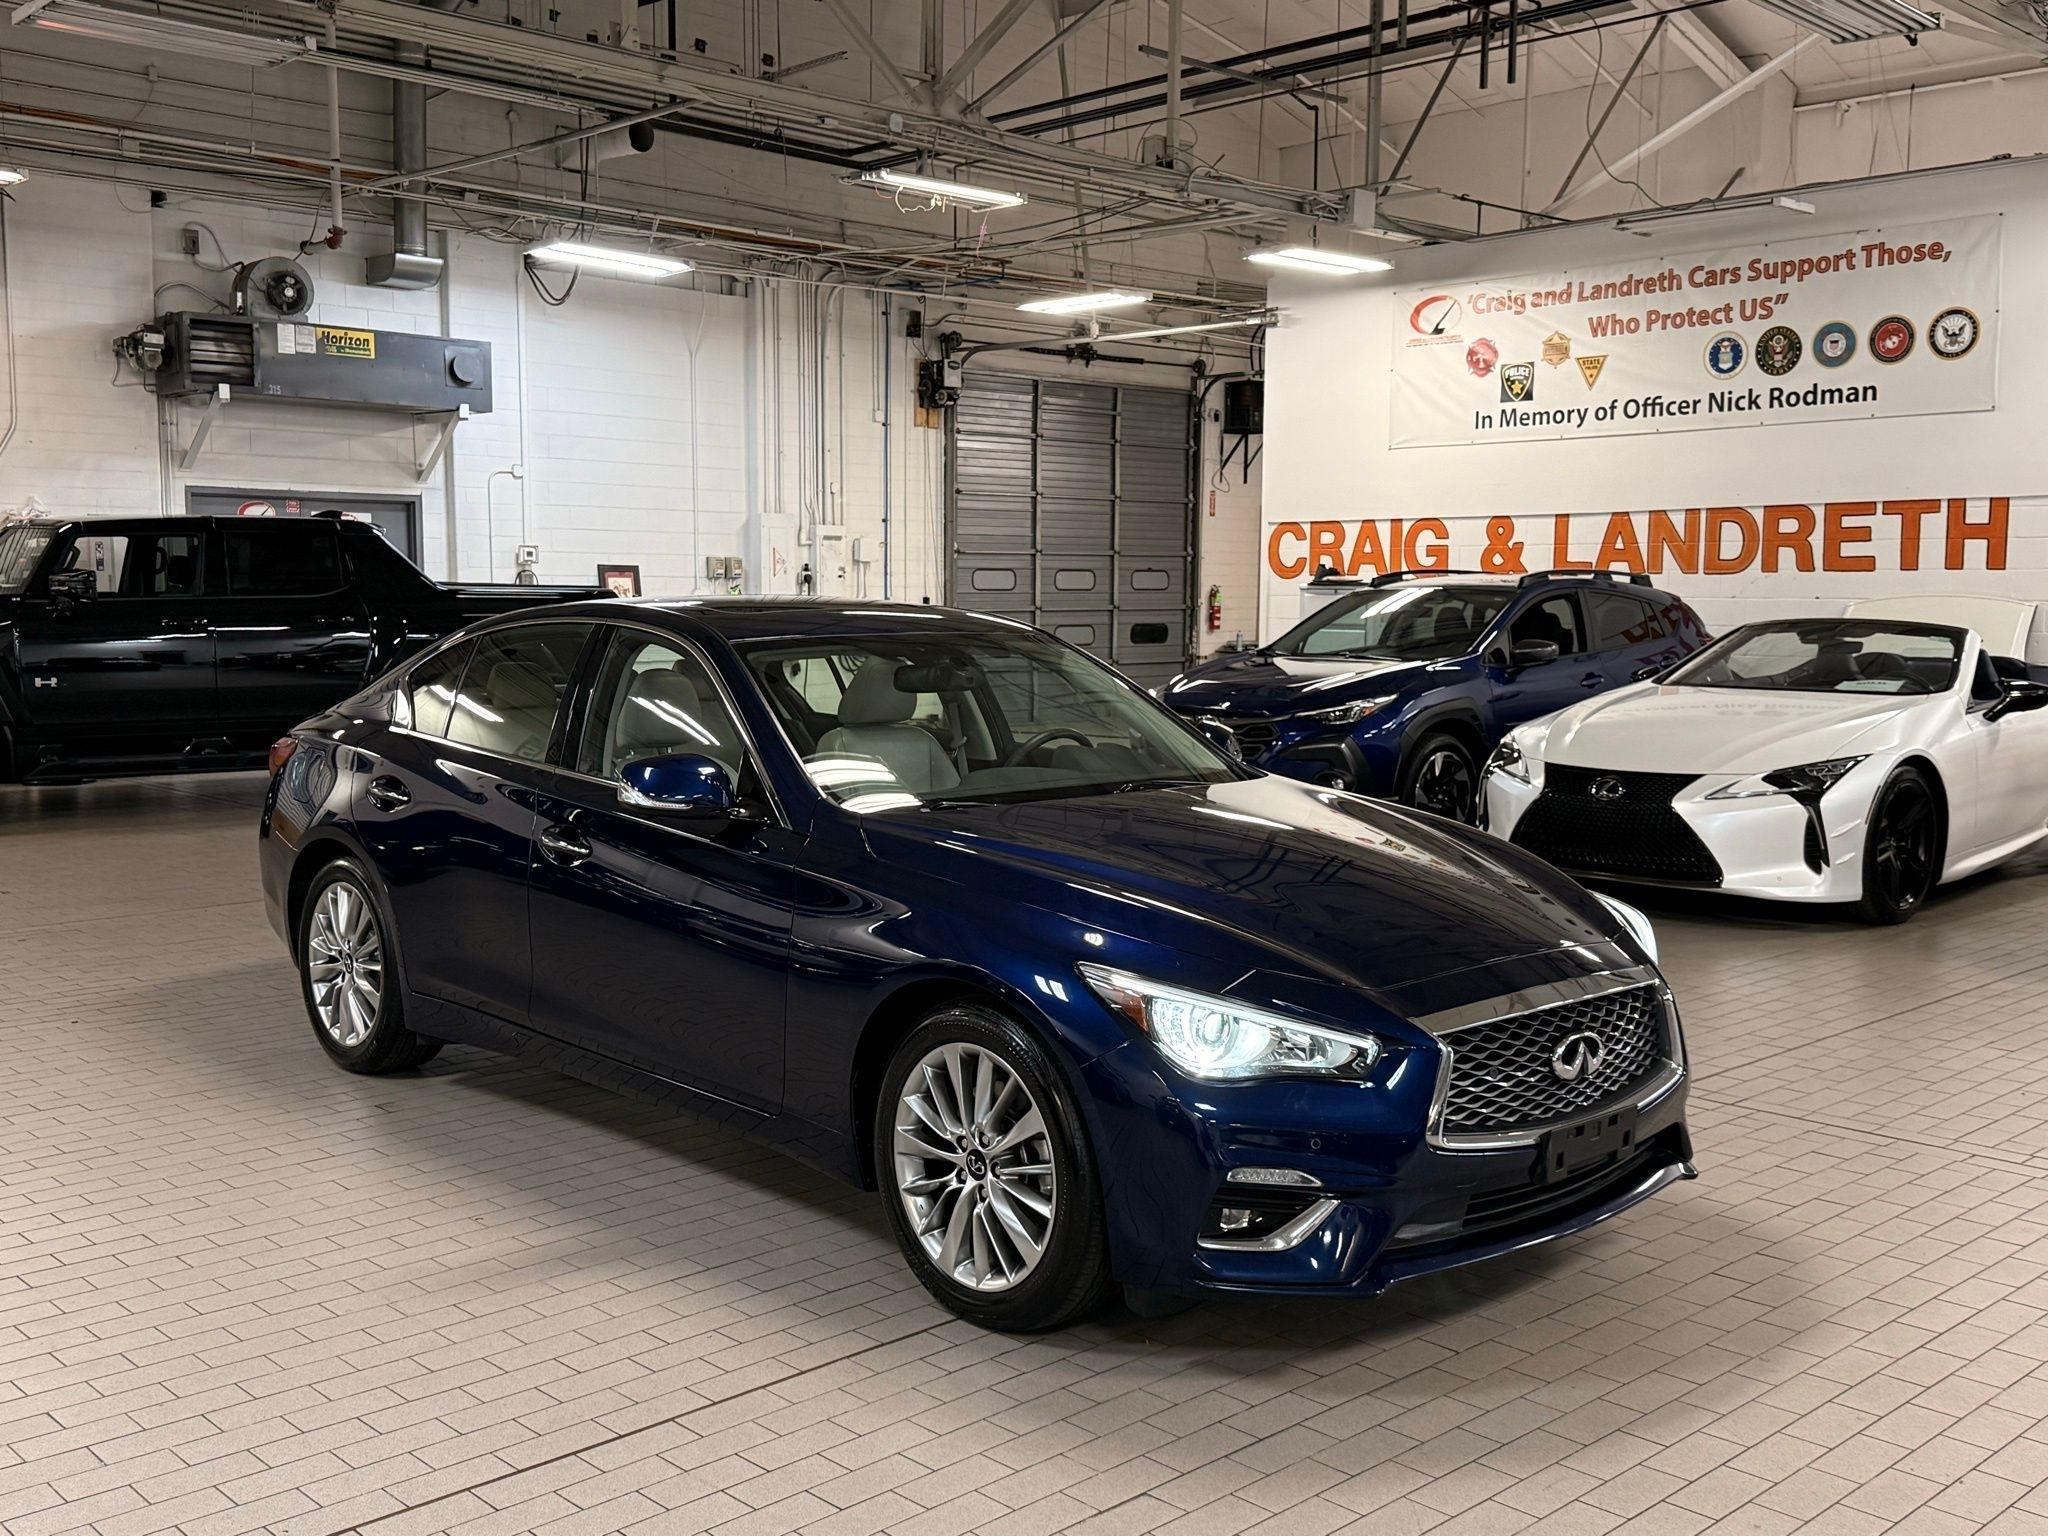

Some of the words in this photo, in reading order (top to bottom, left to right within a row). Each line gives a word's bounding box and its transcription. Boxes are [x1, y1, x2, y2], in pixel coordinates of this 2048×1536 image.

[1531, 282, 1572, 308] and
[1577, 268, 1682, 302] Landreth
[1688, 265, 1741, 288] Cars
[1747, 248, 1856, 283] Support
[1861, 241, 1952, 268] Those,
[321, 331, 370, 348] Horizon
[1588, 313, 1640, 337] Who
[1646, 303, 1733, 332] Protect
[1504, 366, 1530, 379] POLICE
[1475, 411, 1493, 430] In
[1499, 407, 1589, 429] Memory
[1594, 399, 1618, 421] of
[1623, 395, 1702, 420] Officer
[1708, 388, 1762, 413] Nick
[1769, 383, 1878, 409] Rodman
[1268, 517, 1449, 580] CRAIG
[1480, 515, 1528, 575] &
[1552, 496, 2010, 578] LANDRETH
